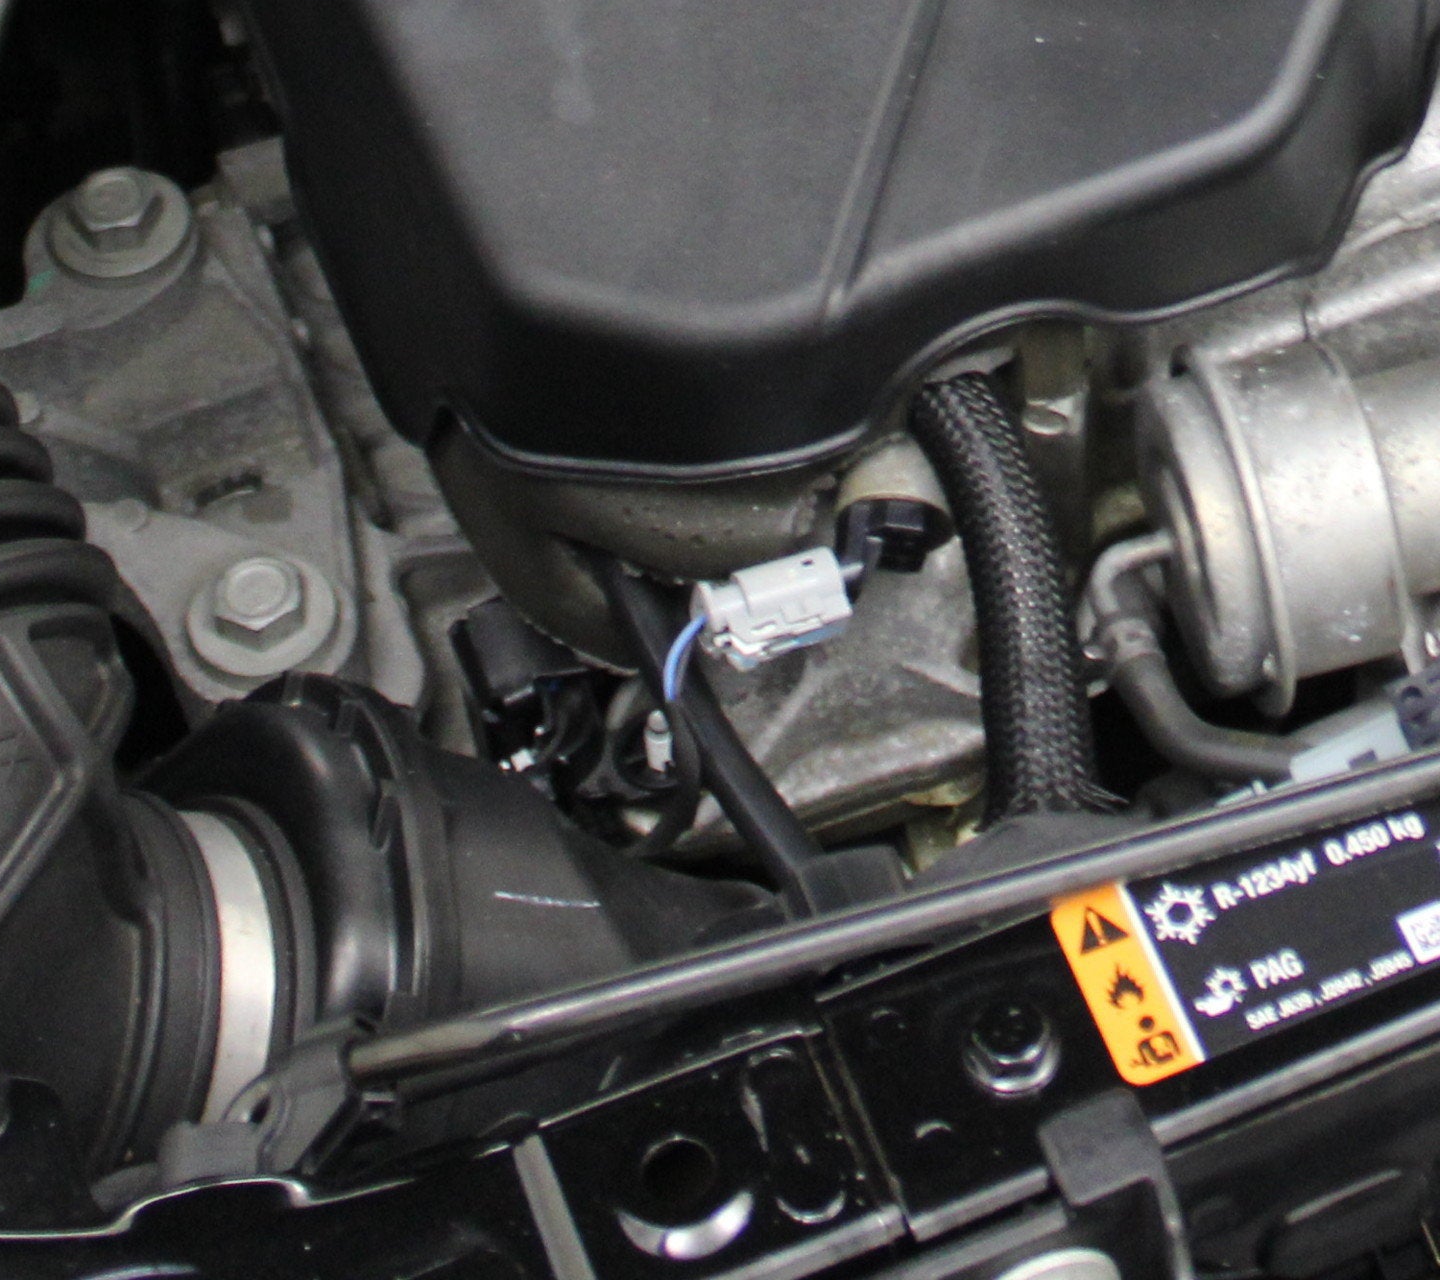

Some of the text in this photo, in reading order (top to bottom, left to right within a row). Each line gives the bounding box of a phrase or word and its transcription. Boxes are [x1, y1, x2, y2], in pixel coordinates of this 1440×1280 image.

[1212, 813, 1425, 908] R-1234yf 0.450 kg
[1250, 950, 1304, 988] PAG
[1245, 1005, 1279, 1030] SAE
